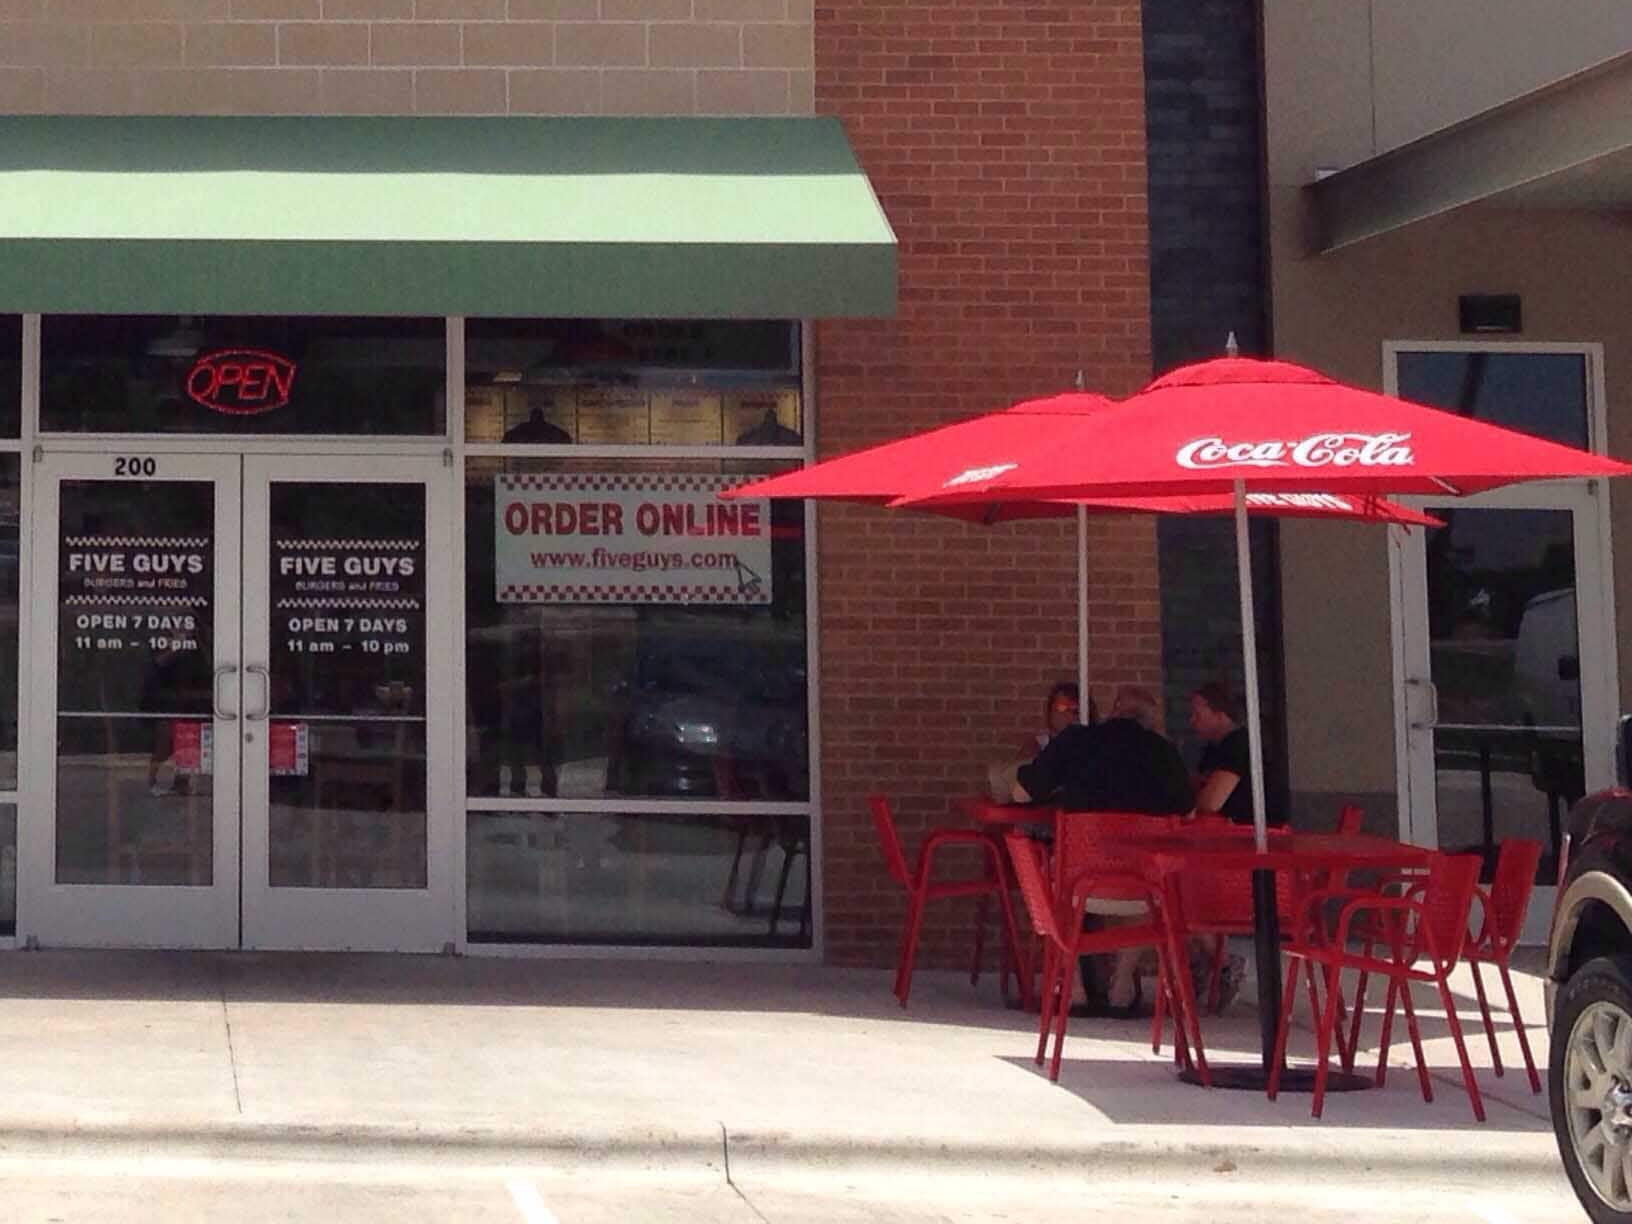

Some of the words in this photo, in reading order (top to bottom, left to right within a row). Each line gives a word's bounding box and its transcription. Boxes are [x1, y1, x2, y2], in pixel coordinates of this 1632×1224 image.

[188, 362, 296, 400] OPEN
[1175, 432, 1415, 469] Coca-Cola
[115, 457, 156, 476] 200
[504, 501, 624, 536] ORDER
[635, 501, 761, 536] ONLINE
[69, 554, 125, 572] FIVE
[133, 554, 204, 573] GUYS
[280, 557, 336, 575] FIVE
[344, 557, 415, 575] GUYS
[530, 547, 737, 571] www.fiveguys.com
[76, 615, 127, 629] OPEN
[132, 616, 143, 629] 7
[148, 615, 196, 629] DAYS
[288, 618, 339, 632] OPEN
[344, 618, 355, 632] 7
[360, 618, 407, 632] DAYS
[75, 636, 91, 648] 11
[97, 638, 122, 649] am
[149, 637, 167, 649] 10
[172, 638, 197, 651] pm
[287, 639, 303, 652] 11
[309, 641, 334, 652] am
[361, 640, 380, 652] 10
[383, 641, 409, 655] pm
